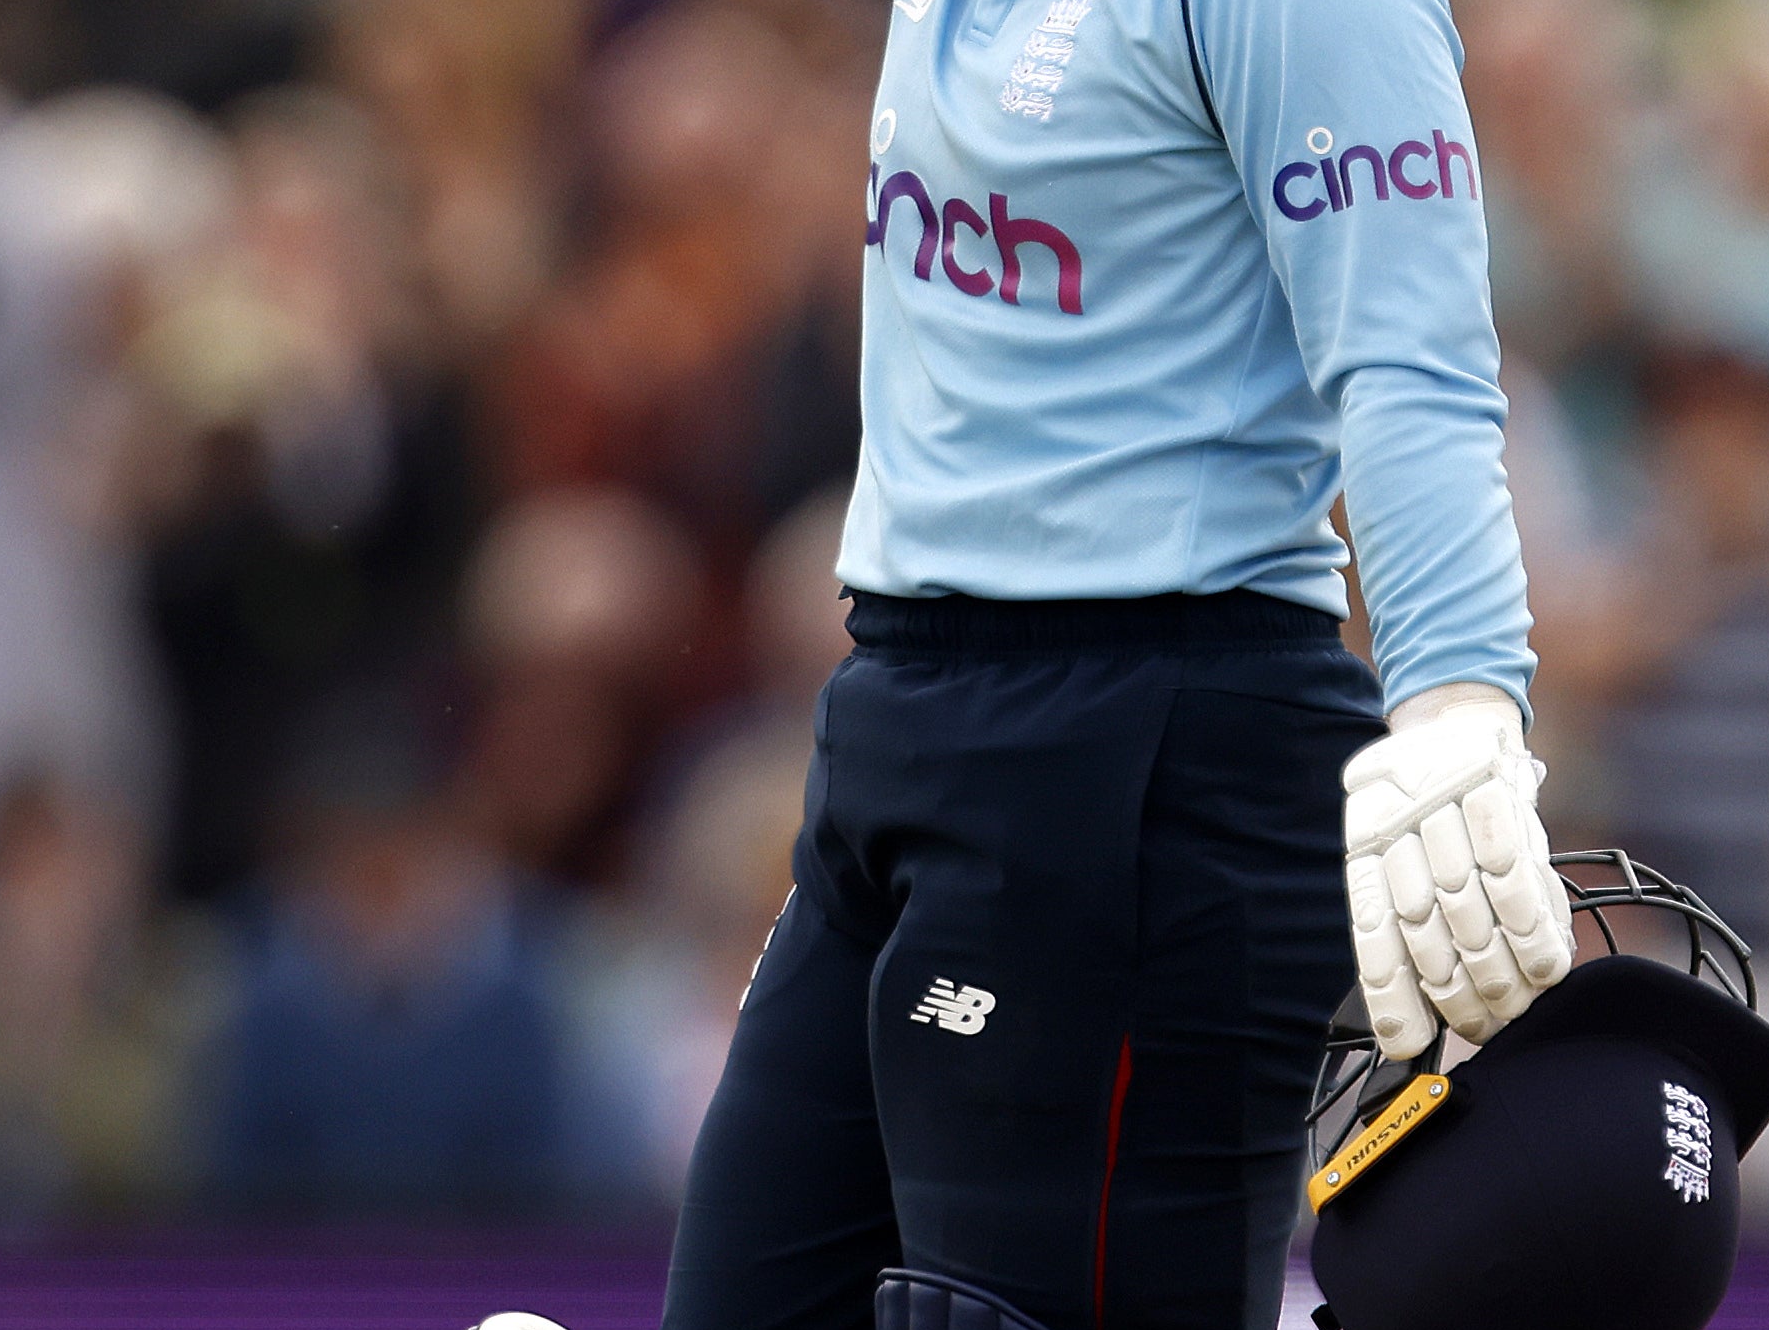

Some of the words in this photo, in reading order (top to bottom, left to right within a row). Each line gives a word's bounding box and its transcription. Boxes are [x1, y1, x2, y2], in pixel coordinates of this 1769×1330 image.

[866, 108, 1084, 316] inch
[1273, 126, 1479, 222] cinch
[1346, 1100, 1422, 1171] MASURI
